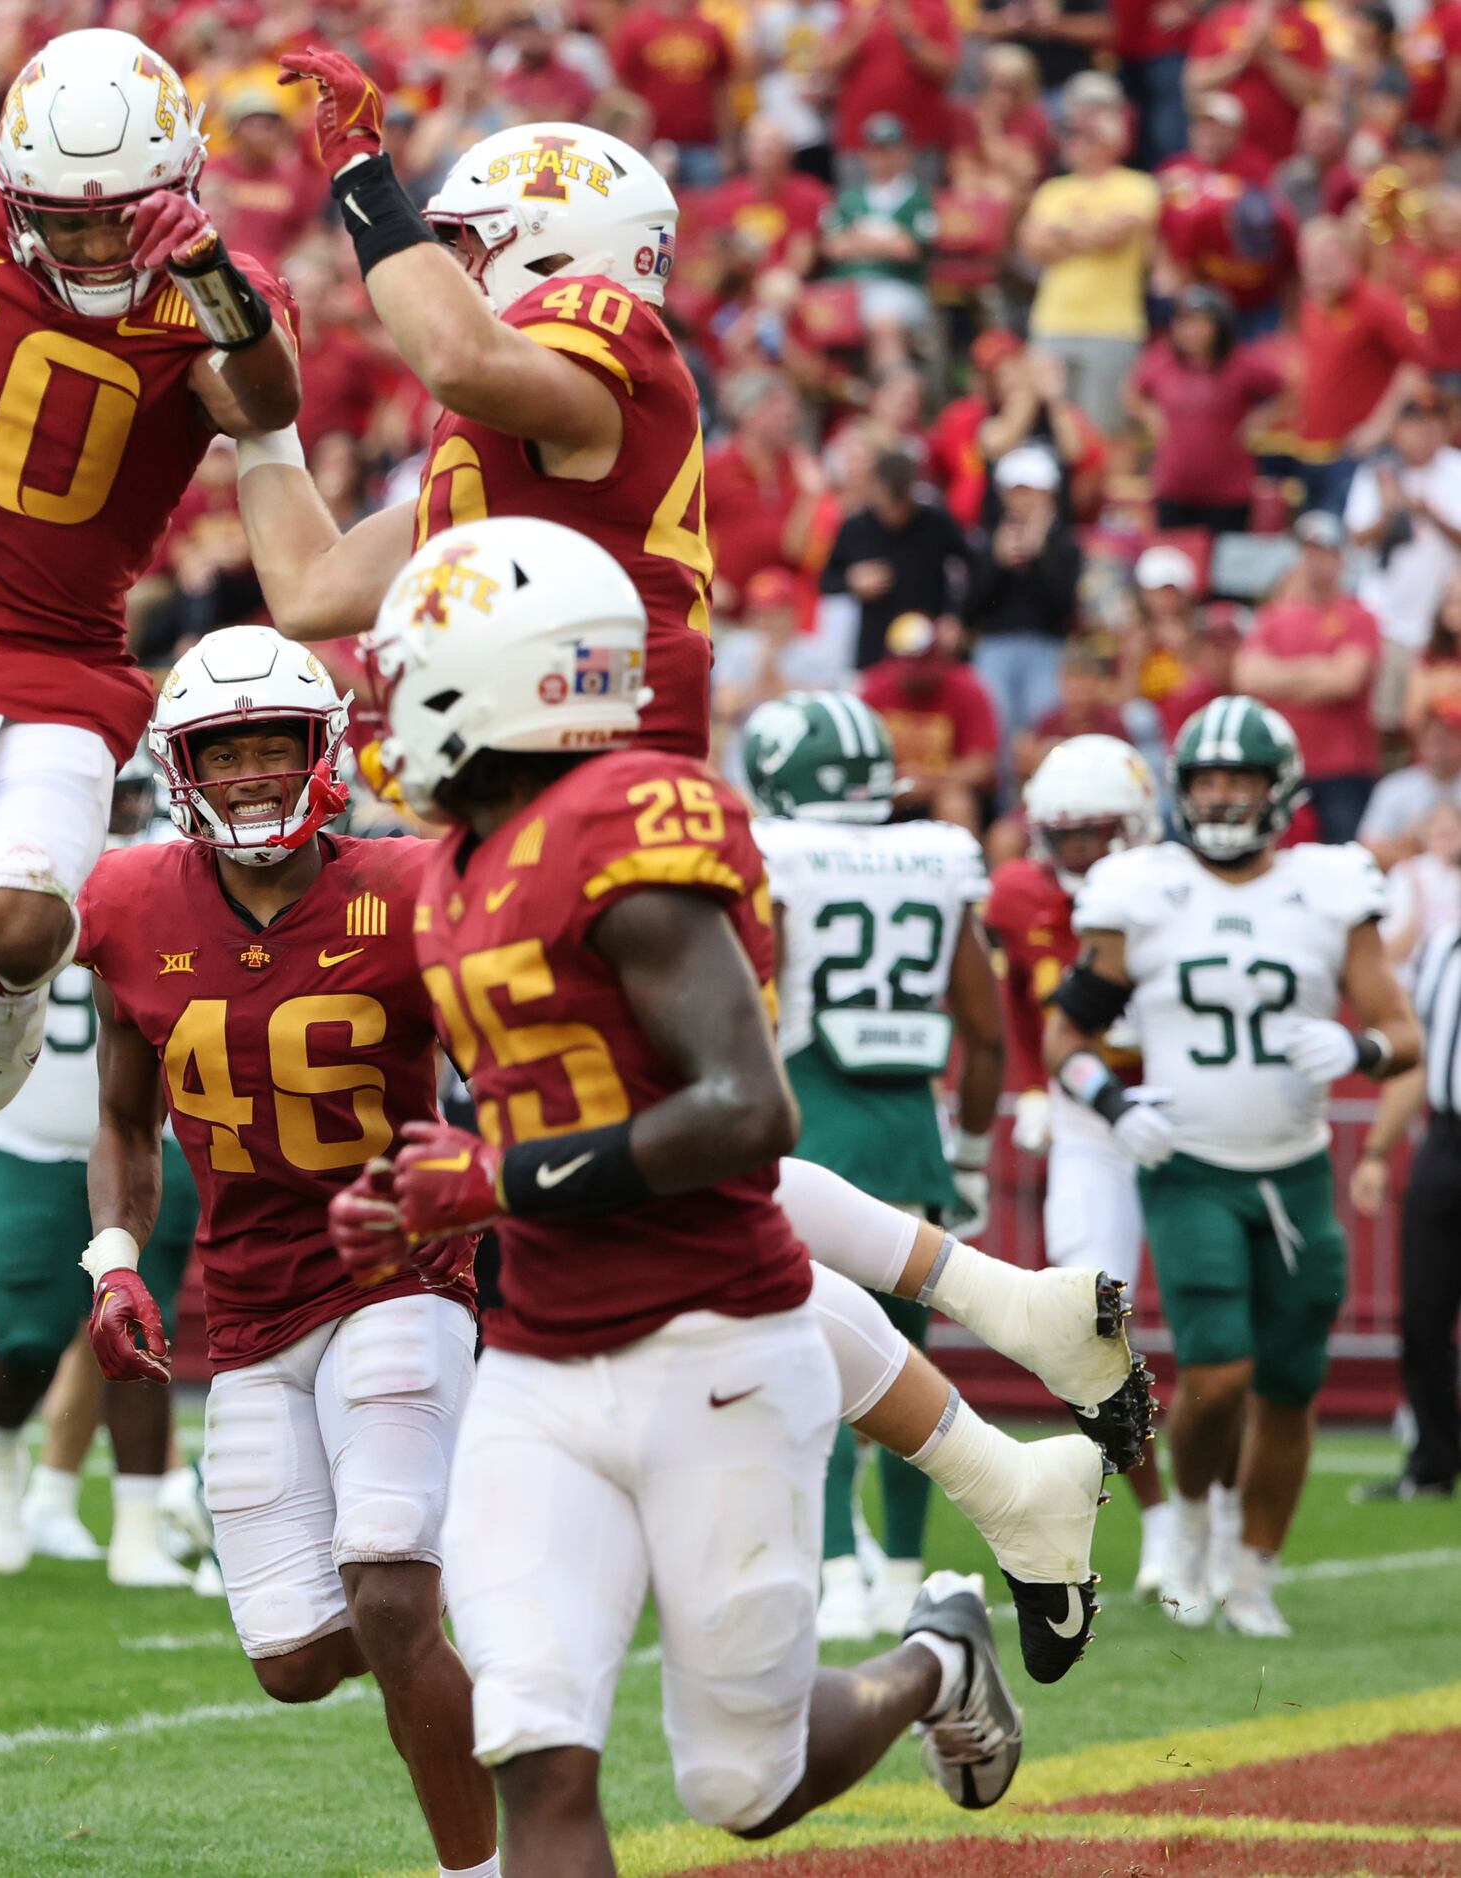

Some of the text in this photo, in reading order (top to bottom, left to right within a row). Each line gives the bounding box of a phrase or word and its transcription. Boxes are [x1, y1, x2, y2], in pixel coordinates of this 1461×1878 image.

[488, 149, 612, 197] STATE
[542, 283, 633, 336] 40
[627, 778, 725, 846] 25
[809, 850, 945, 875] WILLIAMS
[160, 951, 195, 976] XII
[240, 950, 271, 964] STATE
[812, 901, 943, 1006] 22
[1179, 957, 1296, 1065] 52
[164, 993, 393, 1174] 46
